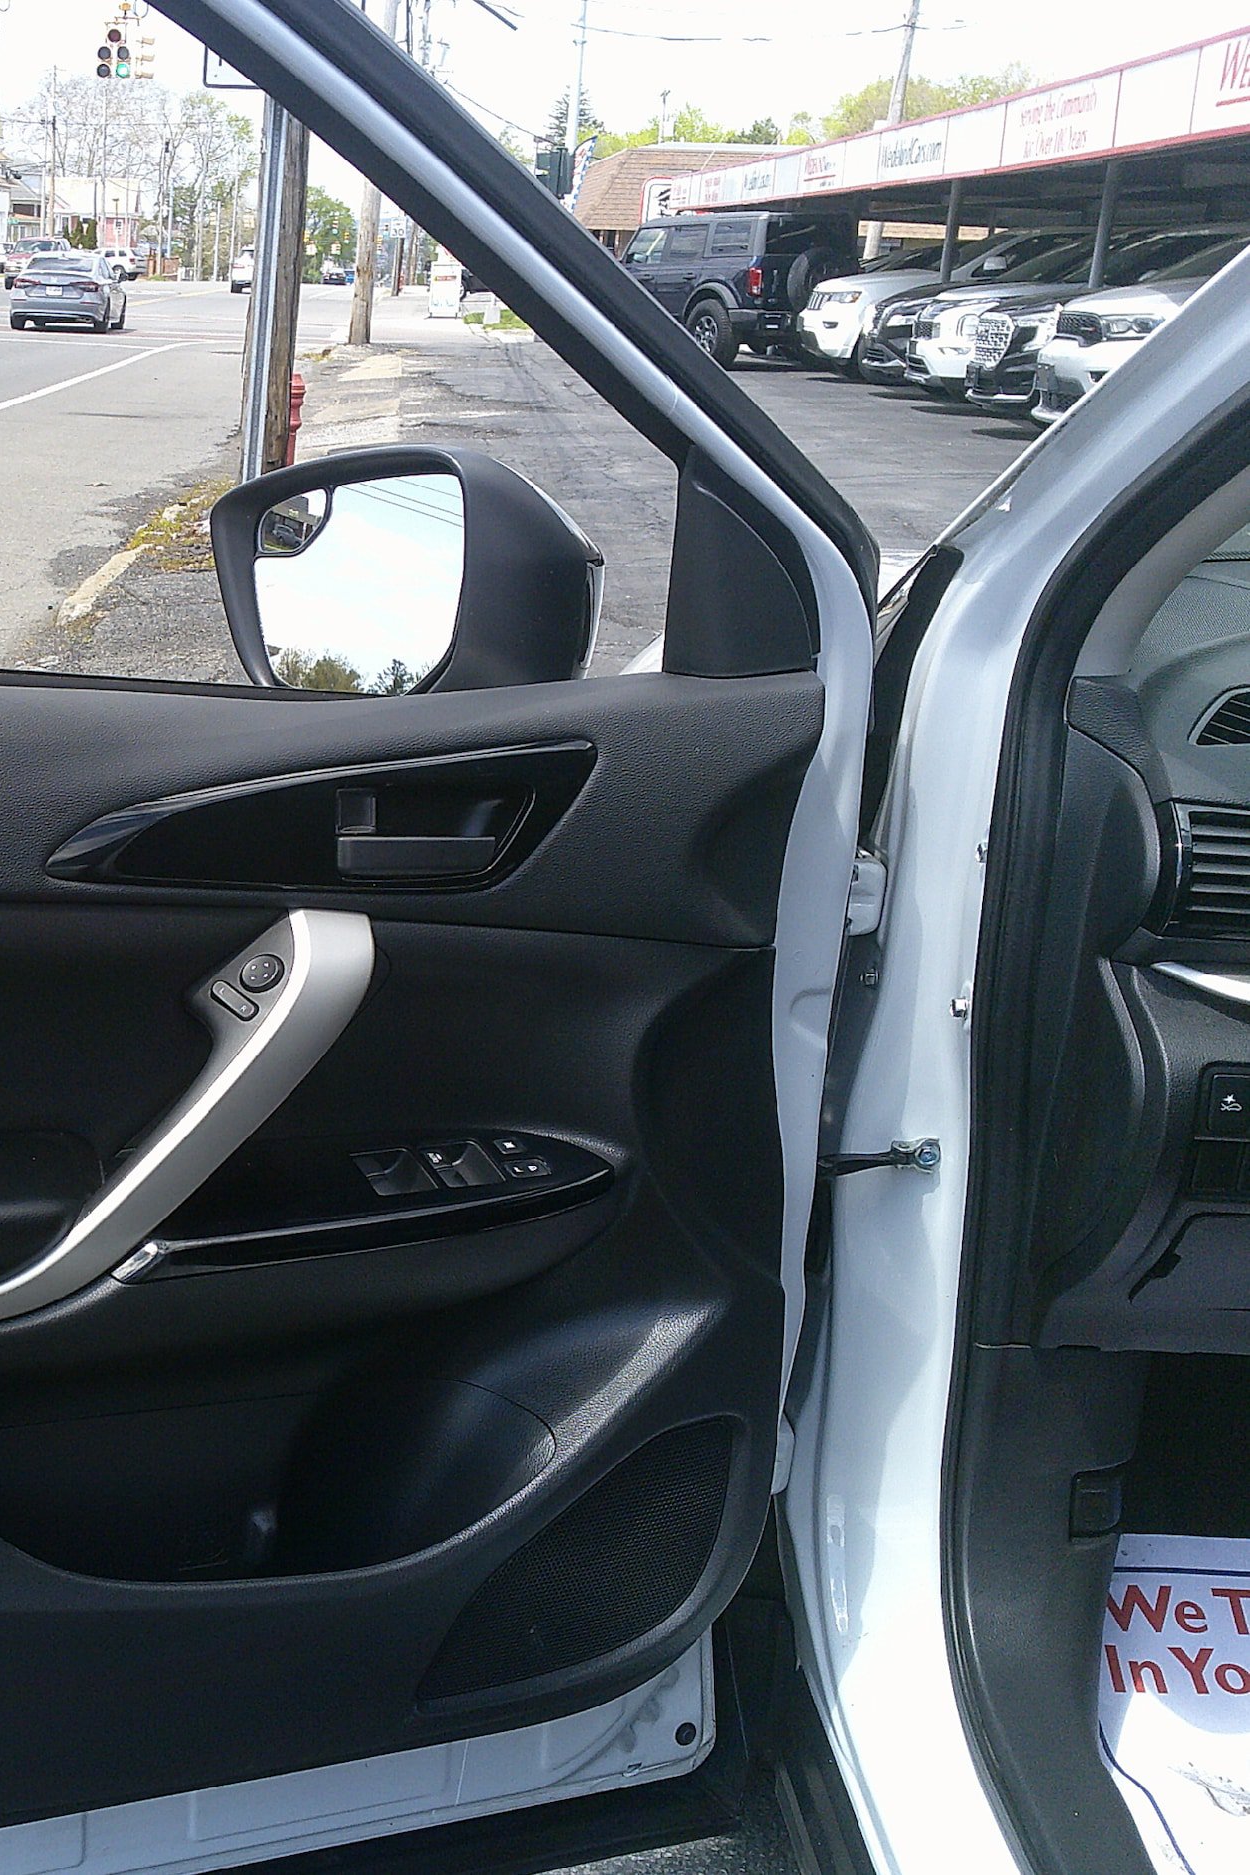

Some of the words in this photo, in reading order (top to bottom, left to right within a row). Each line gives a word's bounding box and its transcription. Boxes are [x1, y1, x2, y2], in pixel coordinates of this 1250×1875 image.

[1106, 1584, 1208, 1633] We
[1104, 1644, 1168, 1694] In
[1167, 1647, 1250, 1695] Yo
